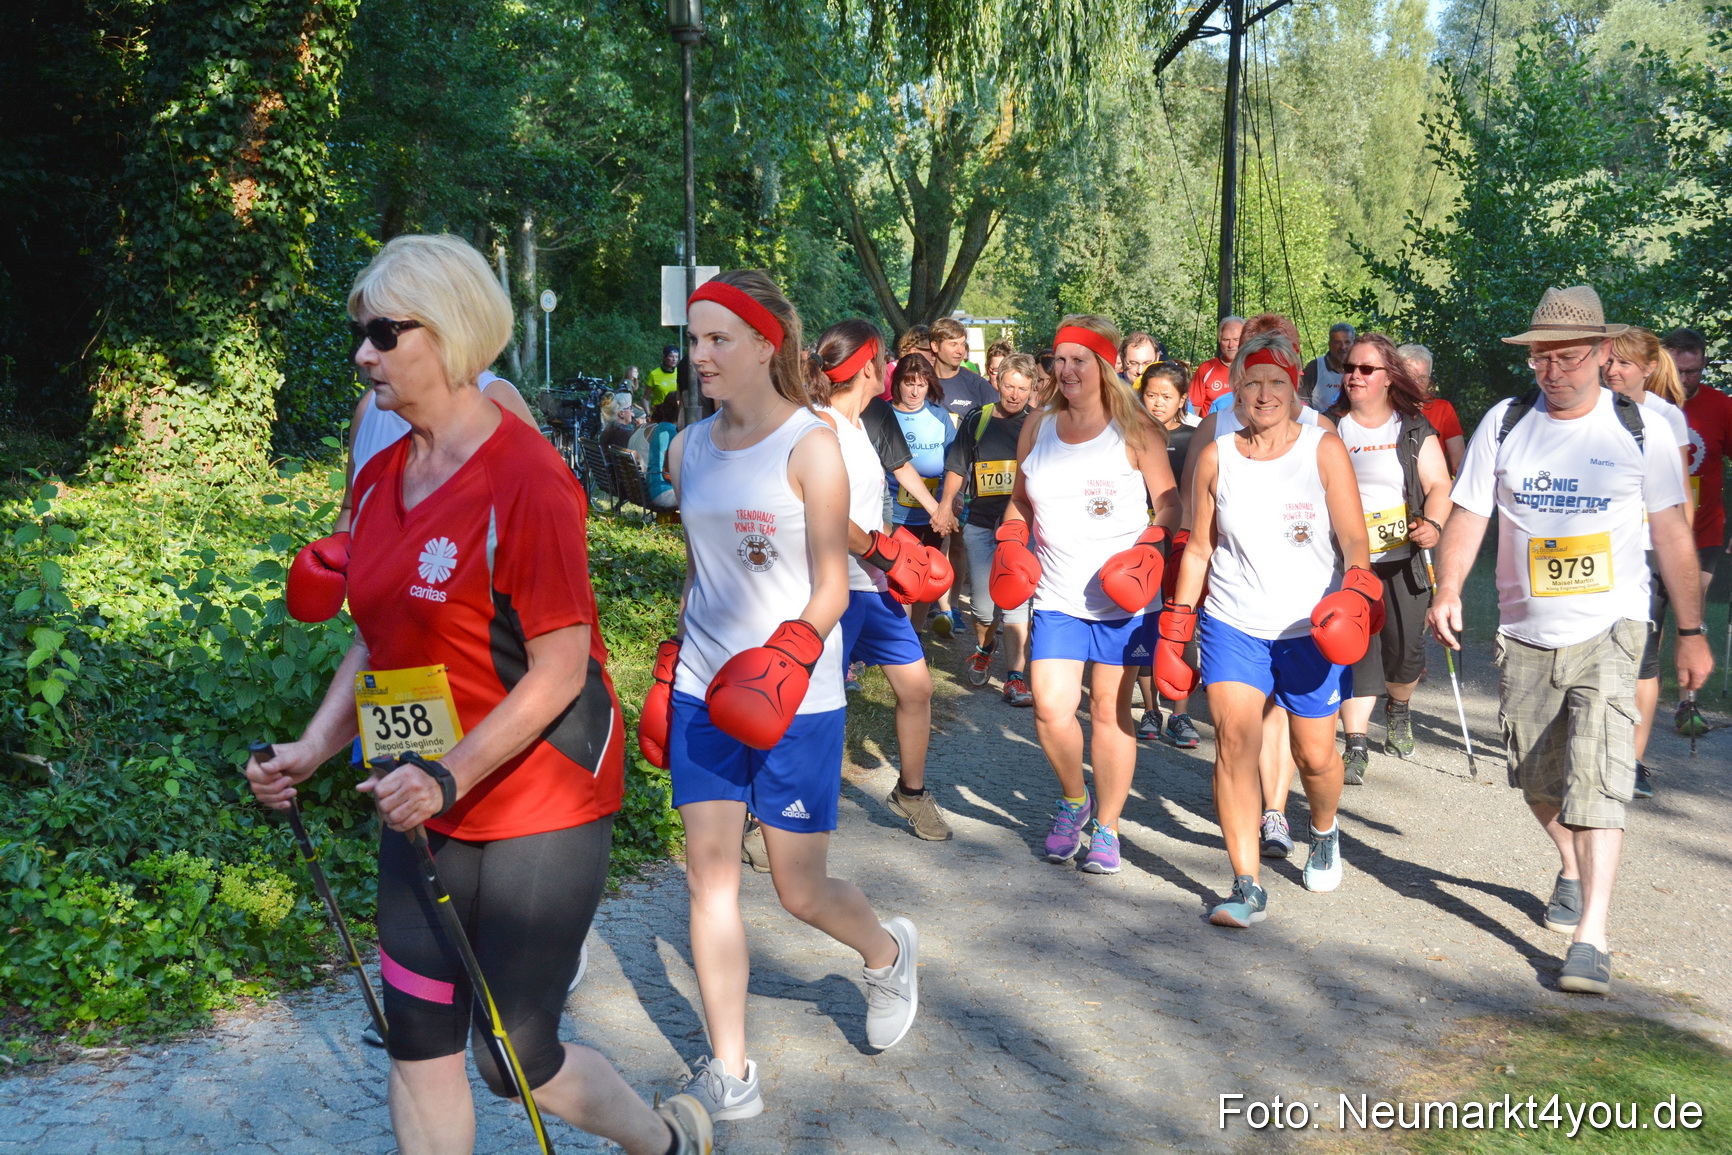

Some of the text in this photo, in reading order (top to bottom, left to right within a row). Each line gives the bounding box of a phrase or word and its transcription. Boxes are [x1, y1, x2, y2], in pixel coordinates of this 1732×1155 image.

[1590, 458, 1614, 467] Martin
[735, 509, 776, 524] TRENDHAUS
[734, 521, 777, 537] POWER TEAM
[1378, 520, 1405, 539] 879
[1547, 555, 1595, 580] 979
[410, 585, 447, 603] caritas
[372, 704, 433, 740] 358
[374, 737, 444, 752] Diepold Sieglinde
[782, 810, 810, 819] adidas
